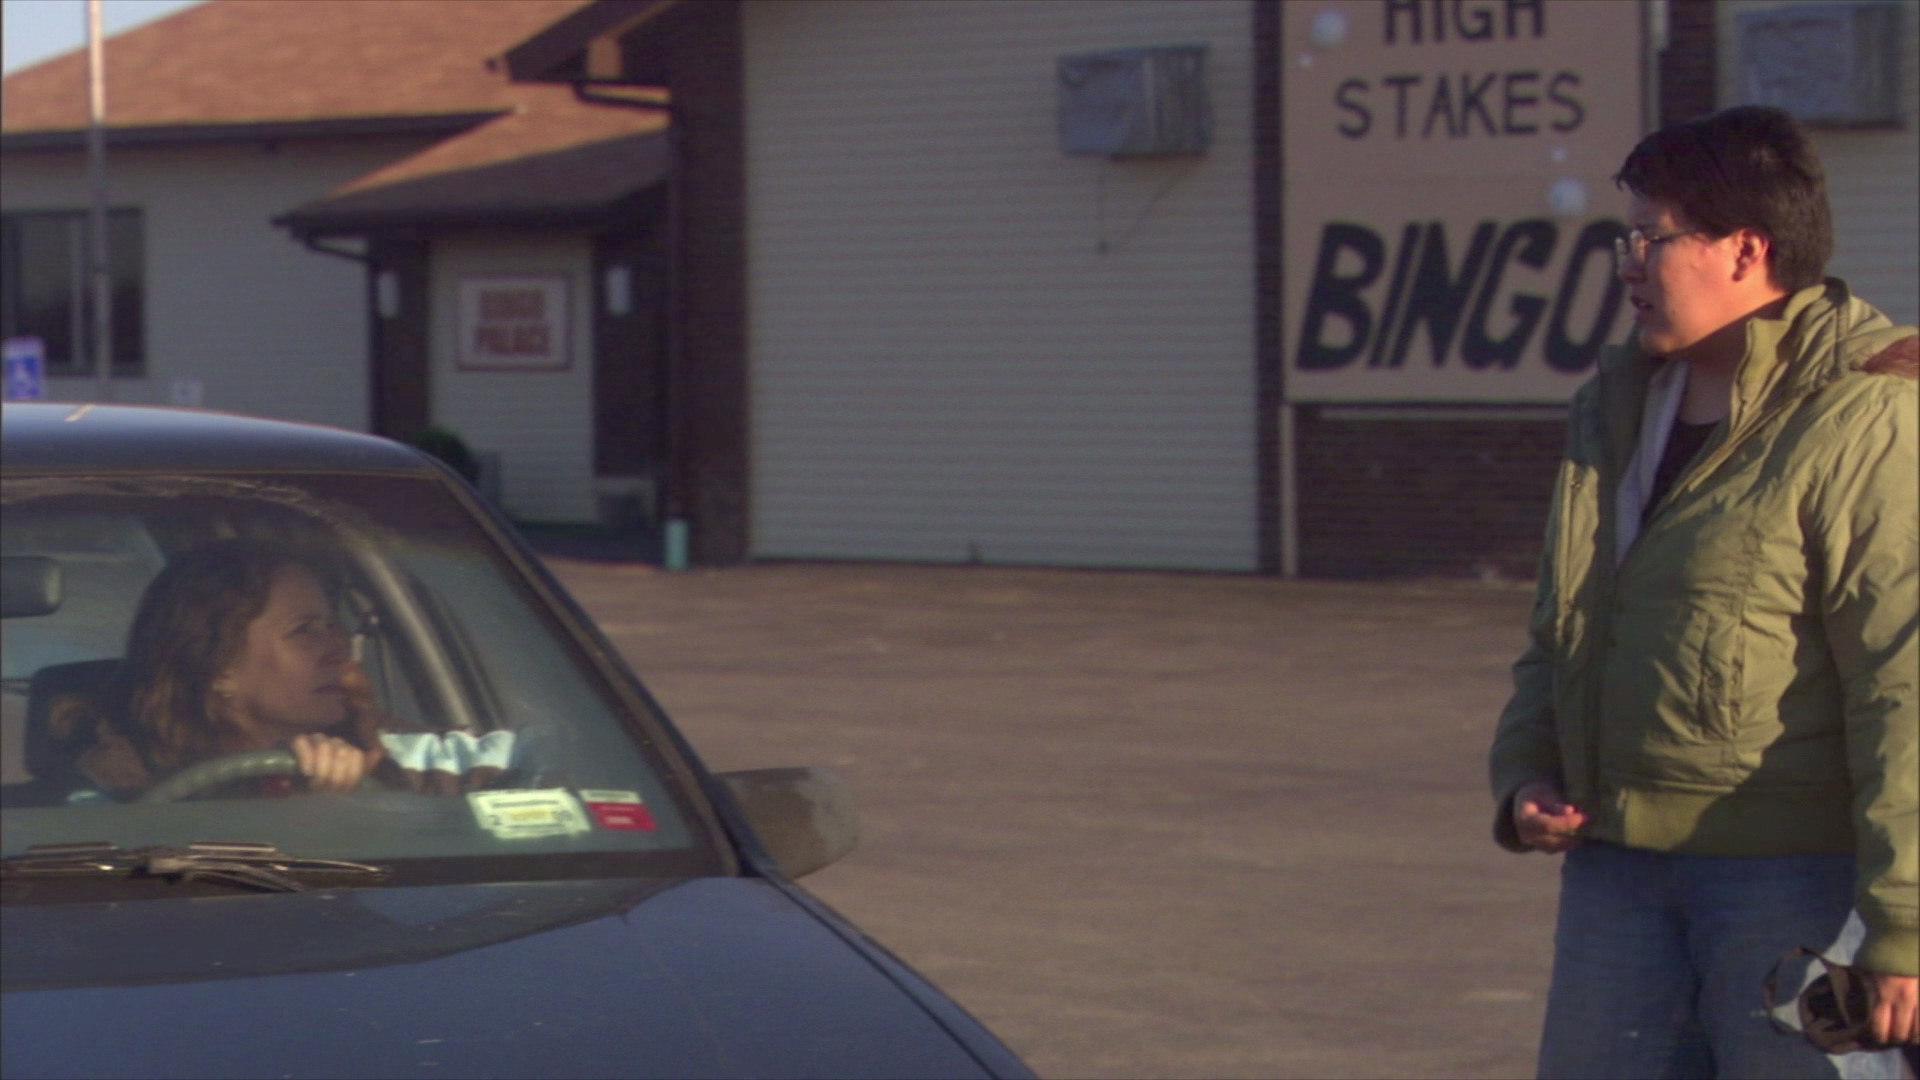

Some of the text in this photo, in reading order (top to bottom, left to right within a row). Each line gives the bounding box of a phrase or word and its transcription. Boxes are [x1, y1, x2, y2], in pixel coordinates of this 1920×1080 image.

[1384, 0, 1546, 44] HIGH
[1335, 71, 1585, 139] STAKES
[1296, 218, 1629, 374] BINGO
